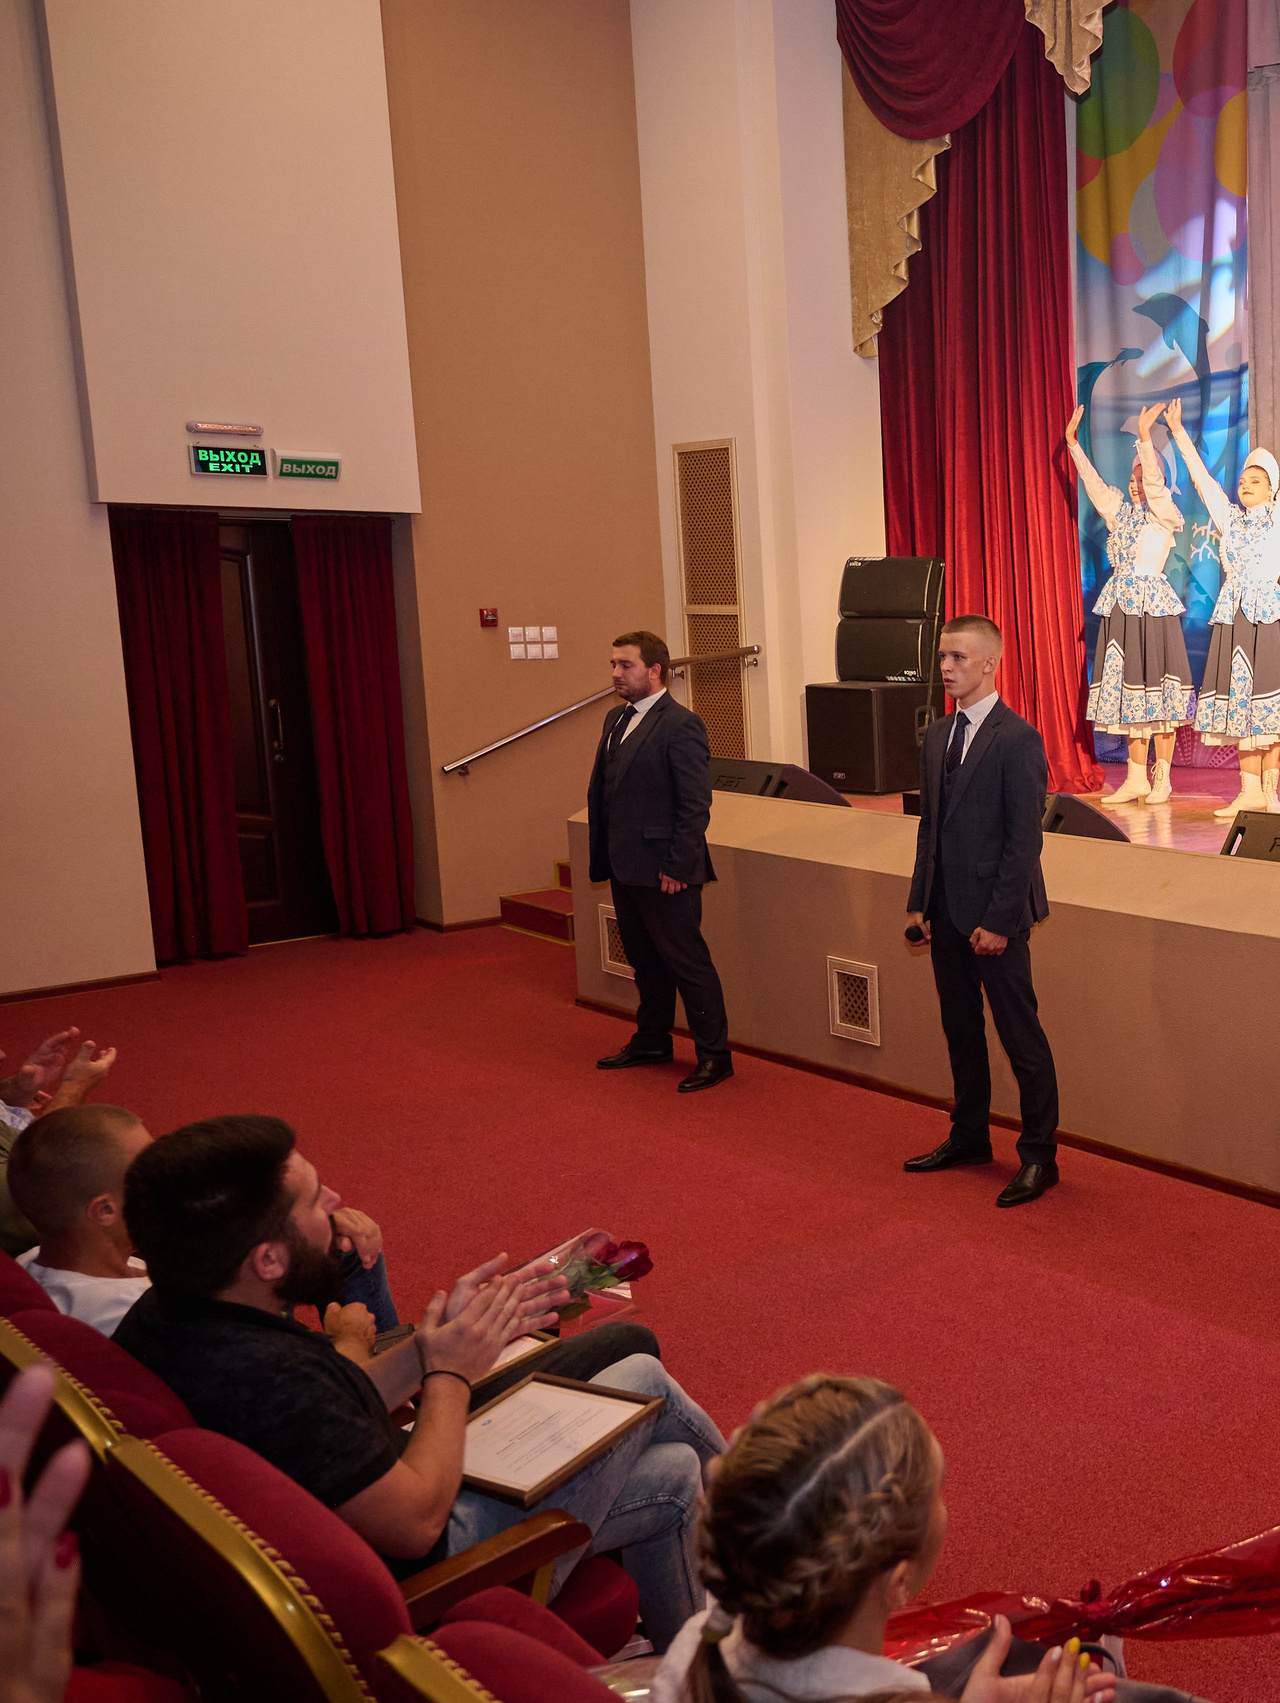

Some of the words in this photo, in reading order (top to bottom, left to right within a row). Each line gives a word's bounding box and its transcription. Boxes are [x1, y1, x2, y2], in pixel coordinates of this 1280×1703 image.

[198, 449, 261, 466] ВЫХОД
[208, 462, 253, 473] EXIT
[282, 463, 337, 477] ВЫХОД
